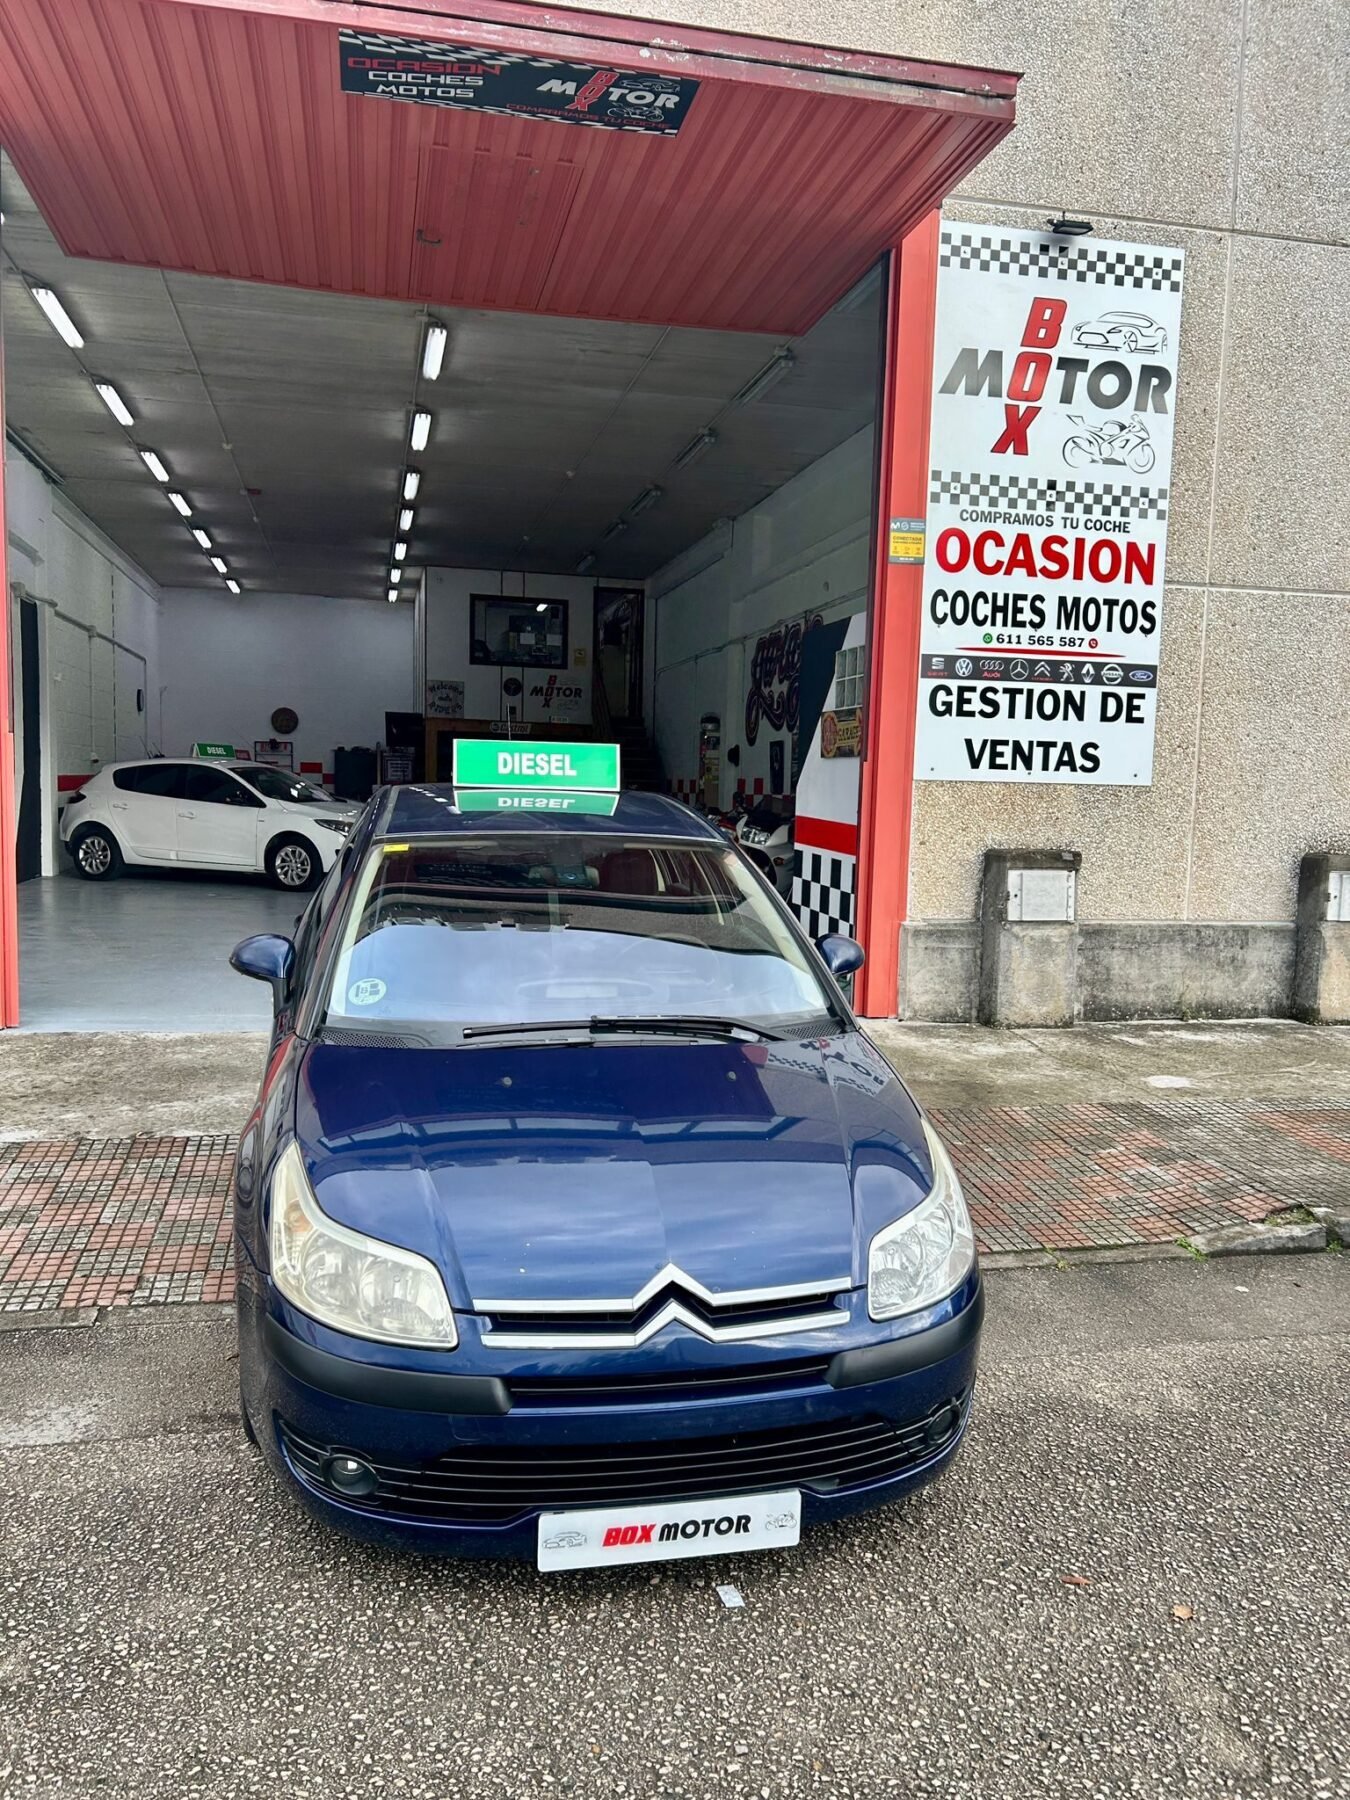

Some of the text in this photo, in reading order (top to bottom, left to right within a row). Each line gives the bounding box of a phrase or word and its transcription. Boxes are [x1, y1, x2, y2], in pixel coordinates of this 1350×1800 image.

[348, 57, 501, 75] OCASION
[368, 71, 483, 86] COCHES
[376, 84, 474, 98] MOTOS
[564, 71, 620, 111] BOX
[506, 103, 599, 120] COMPRAMOS
[622, 119, 672, 128] COCHE
[990, 296, 1068, 456] BOX
[959, 509, 1131, 534] COMPRAMOS TU COCHE
[935, 527, 1156, 585] OCASION
[930, 588, 1157, 635] COCHES MOTOS
[996, 633, 1085, 648] 611 565 587
[928, 684, 1146, 724] GESTION DE
[207, 746, 226, 755] DIESEL
[964, 738, 1100, 773] VENTAS
[497, 752, 577, 776] DIESEL
[602, 1515, 752, 1547] BOX MOTOR
